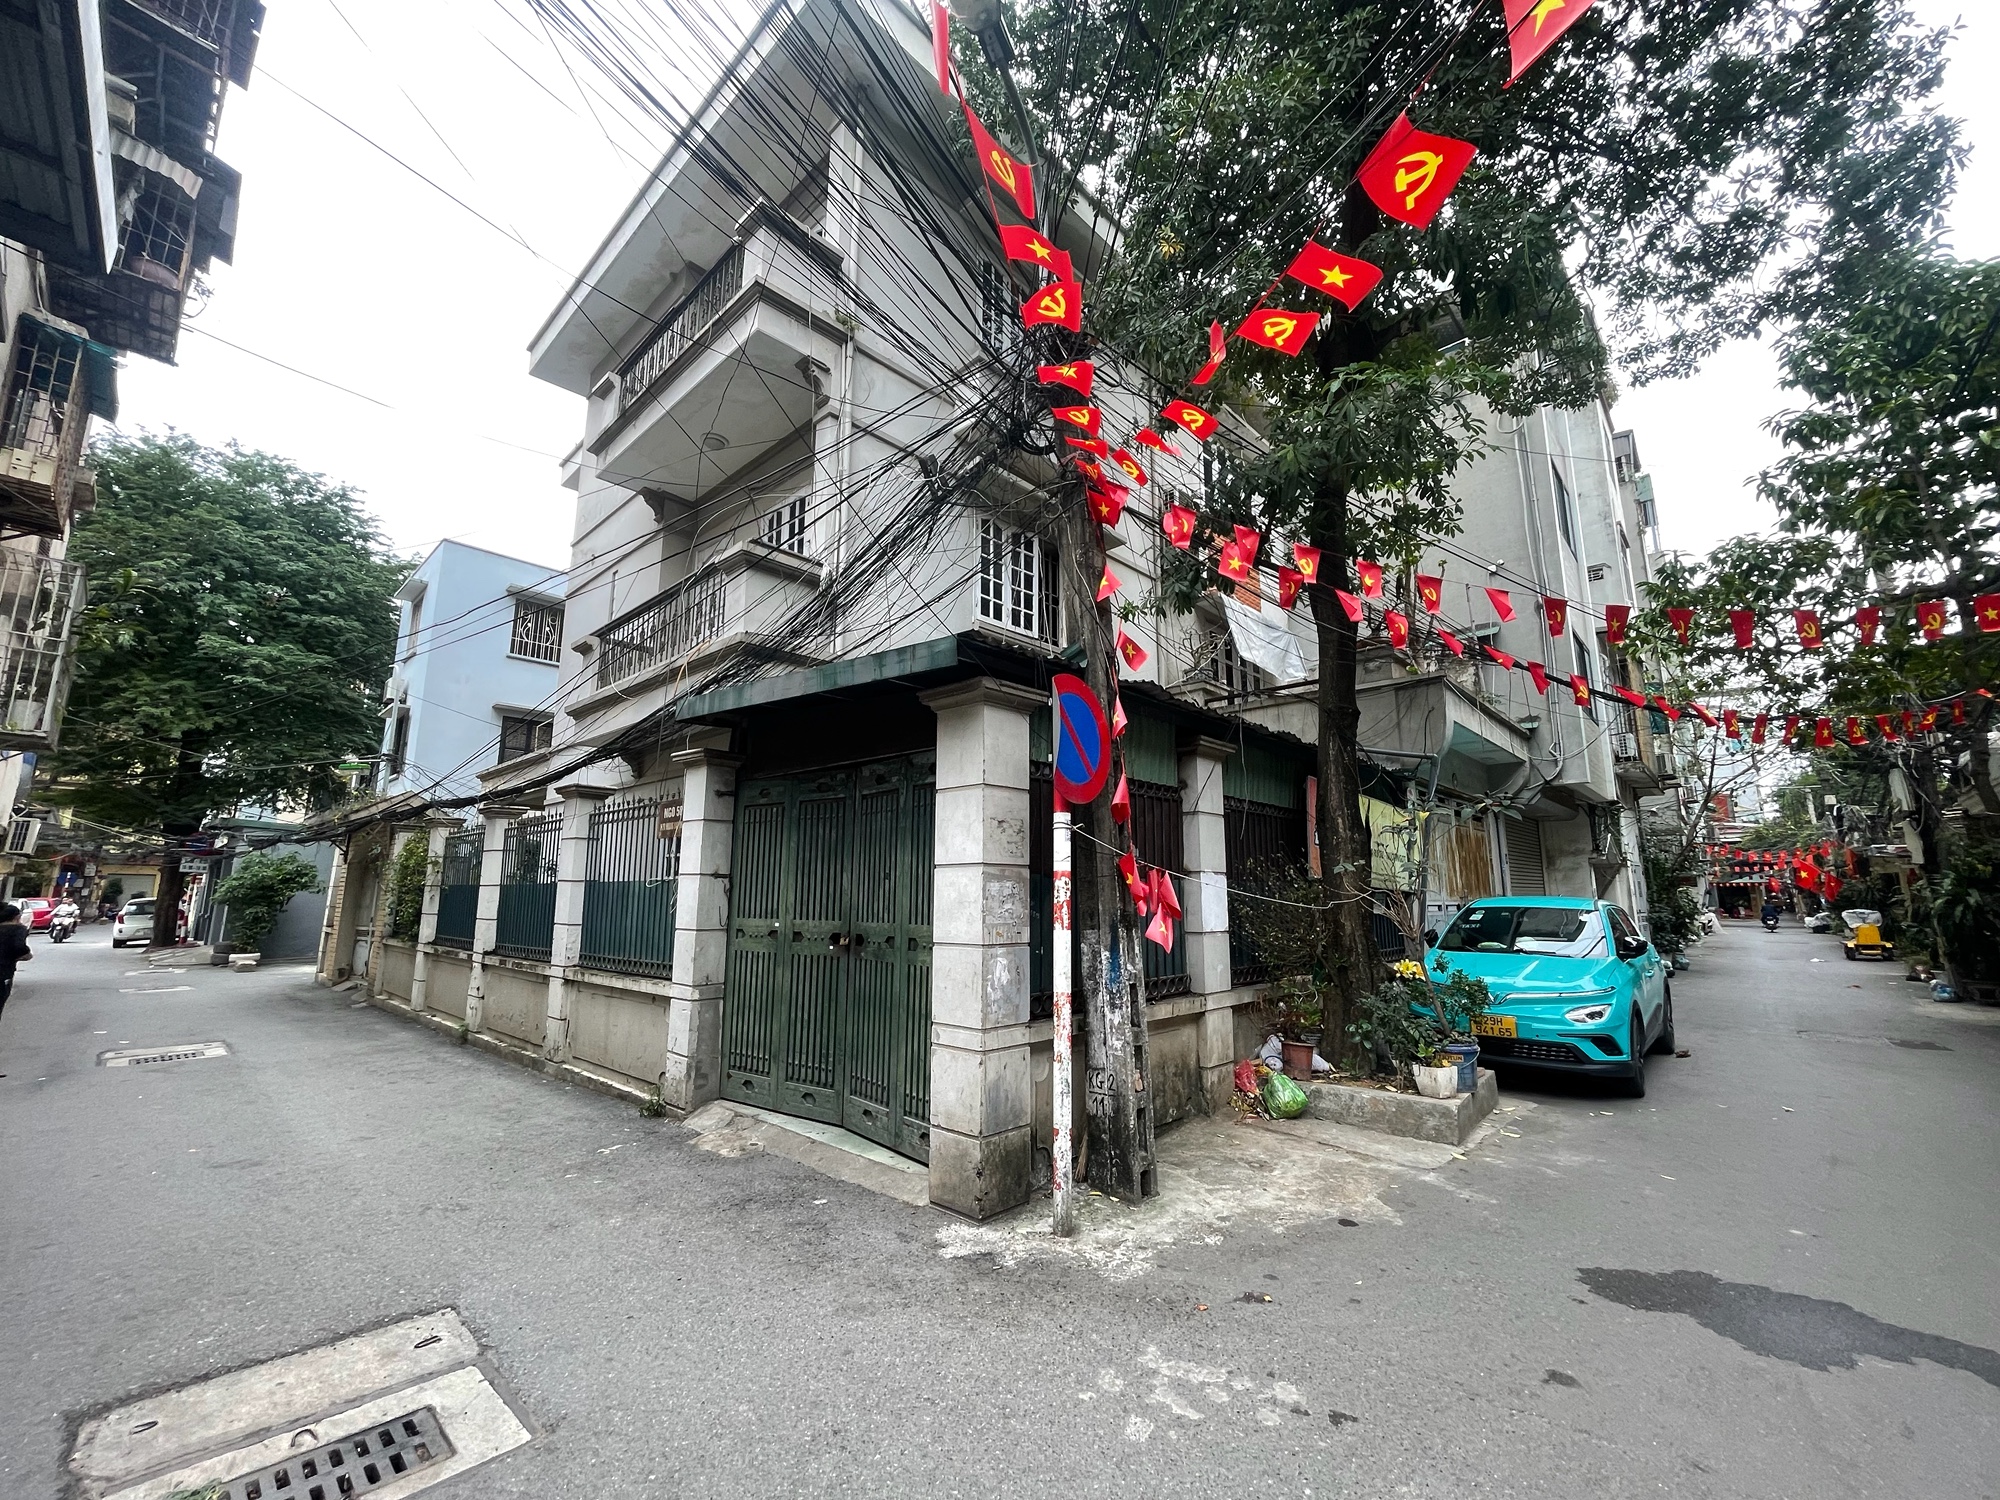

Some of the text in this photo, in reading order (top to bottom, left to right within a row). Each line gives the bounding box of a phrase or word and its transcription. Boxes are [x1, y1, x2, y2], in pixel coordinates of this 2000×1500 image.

[1483, 1016, 1503, 1026] 29H
[1475, 1025, 1512, 1037] 941.65
[1092, 1096, 1105, 1116] 11
